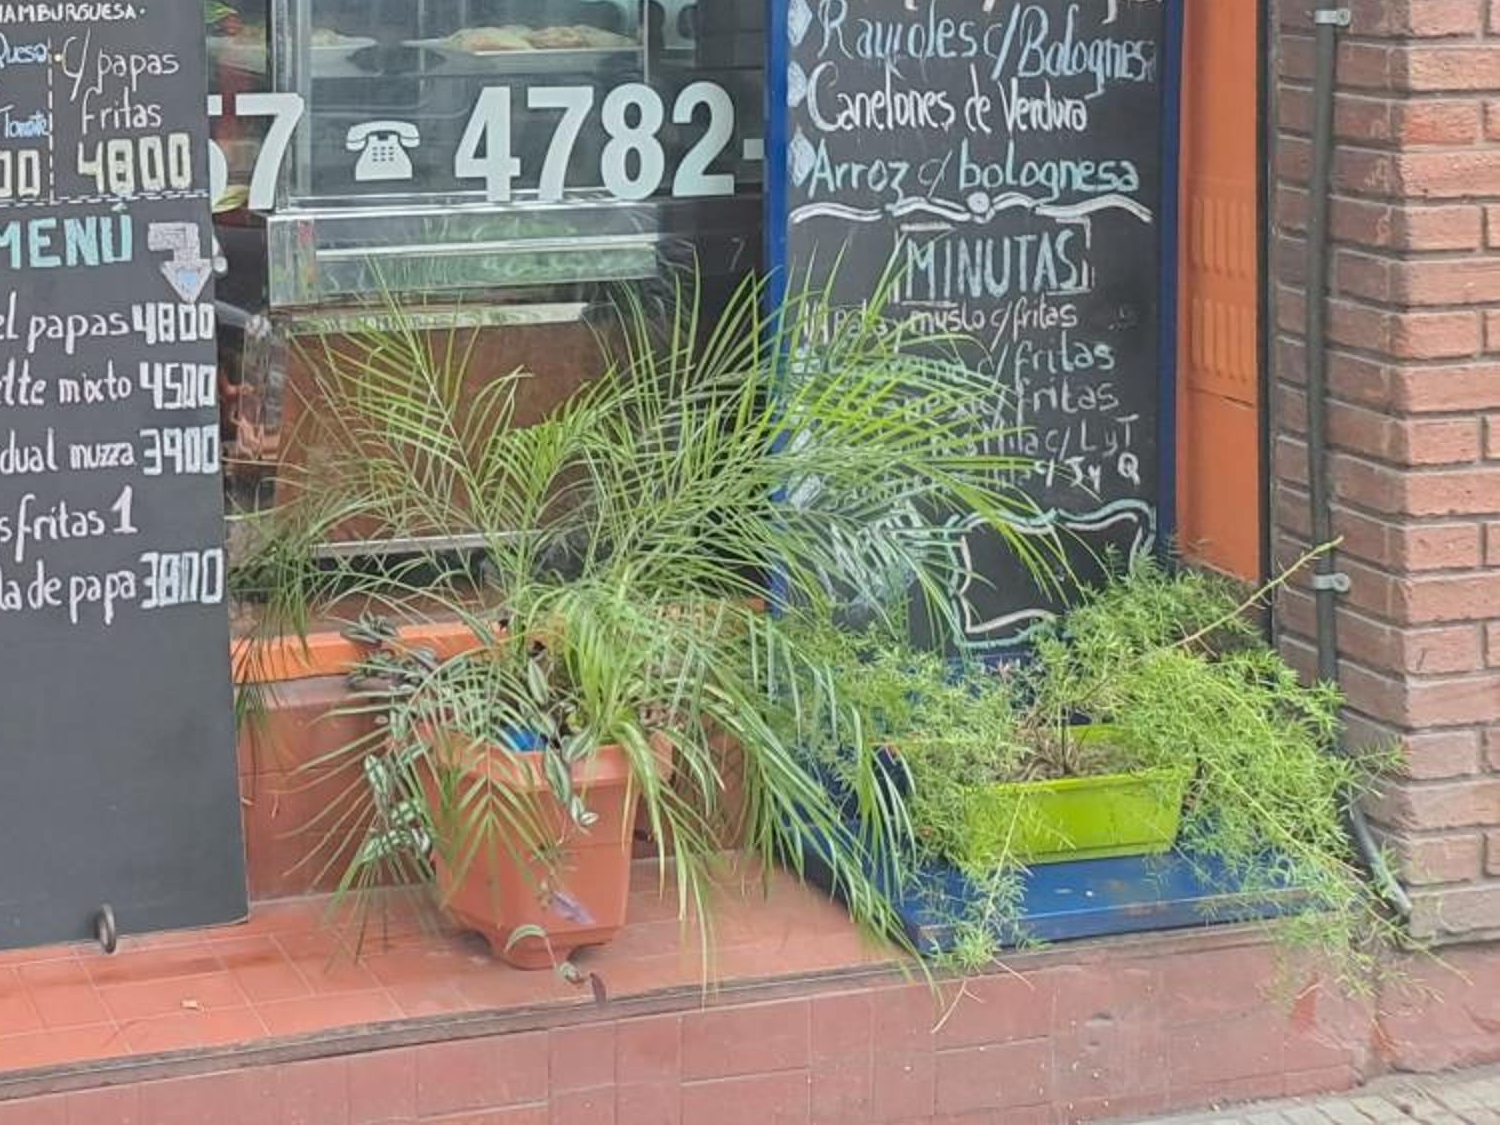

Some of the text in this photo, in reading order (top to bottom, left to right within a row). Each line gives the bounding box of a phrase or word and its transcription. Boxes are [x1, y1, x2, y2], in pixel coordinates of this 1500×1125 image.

[96, 48, 181, 95] papas
[964, 62, 992, 133] de
[77, 132, 191, 197] 4800
[808, 139, 910, 207] Arroz
[960, 137, 1140, 204] bolognesa
[906, 229, 1077, 300] MINUTAS
[27, 311, 129, 355] papas
[132, 302, 215, 345] 4800
[58, 359, 132, 404] mixto
[139, 362, 217, 410] 4500
[69, 441, 135, 471] muzza
[140, 424, 220, 476] 3900
[14, 493, 106, 563] fritas
[28, 559, 62, 610] de
[69, 569, 136, 626] papa
[139, 548, 224, 609] 3800
